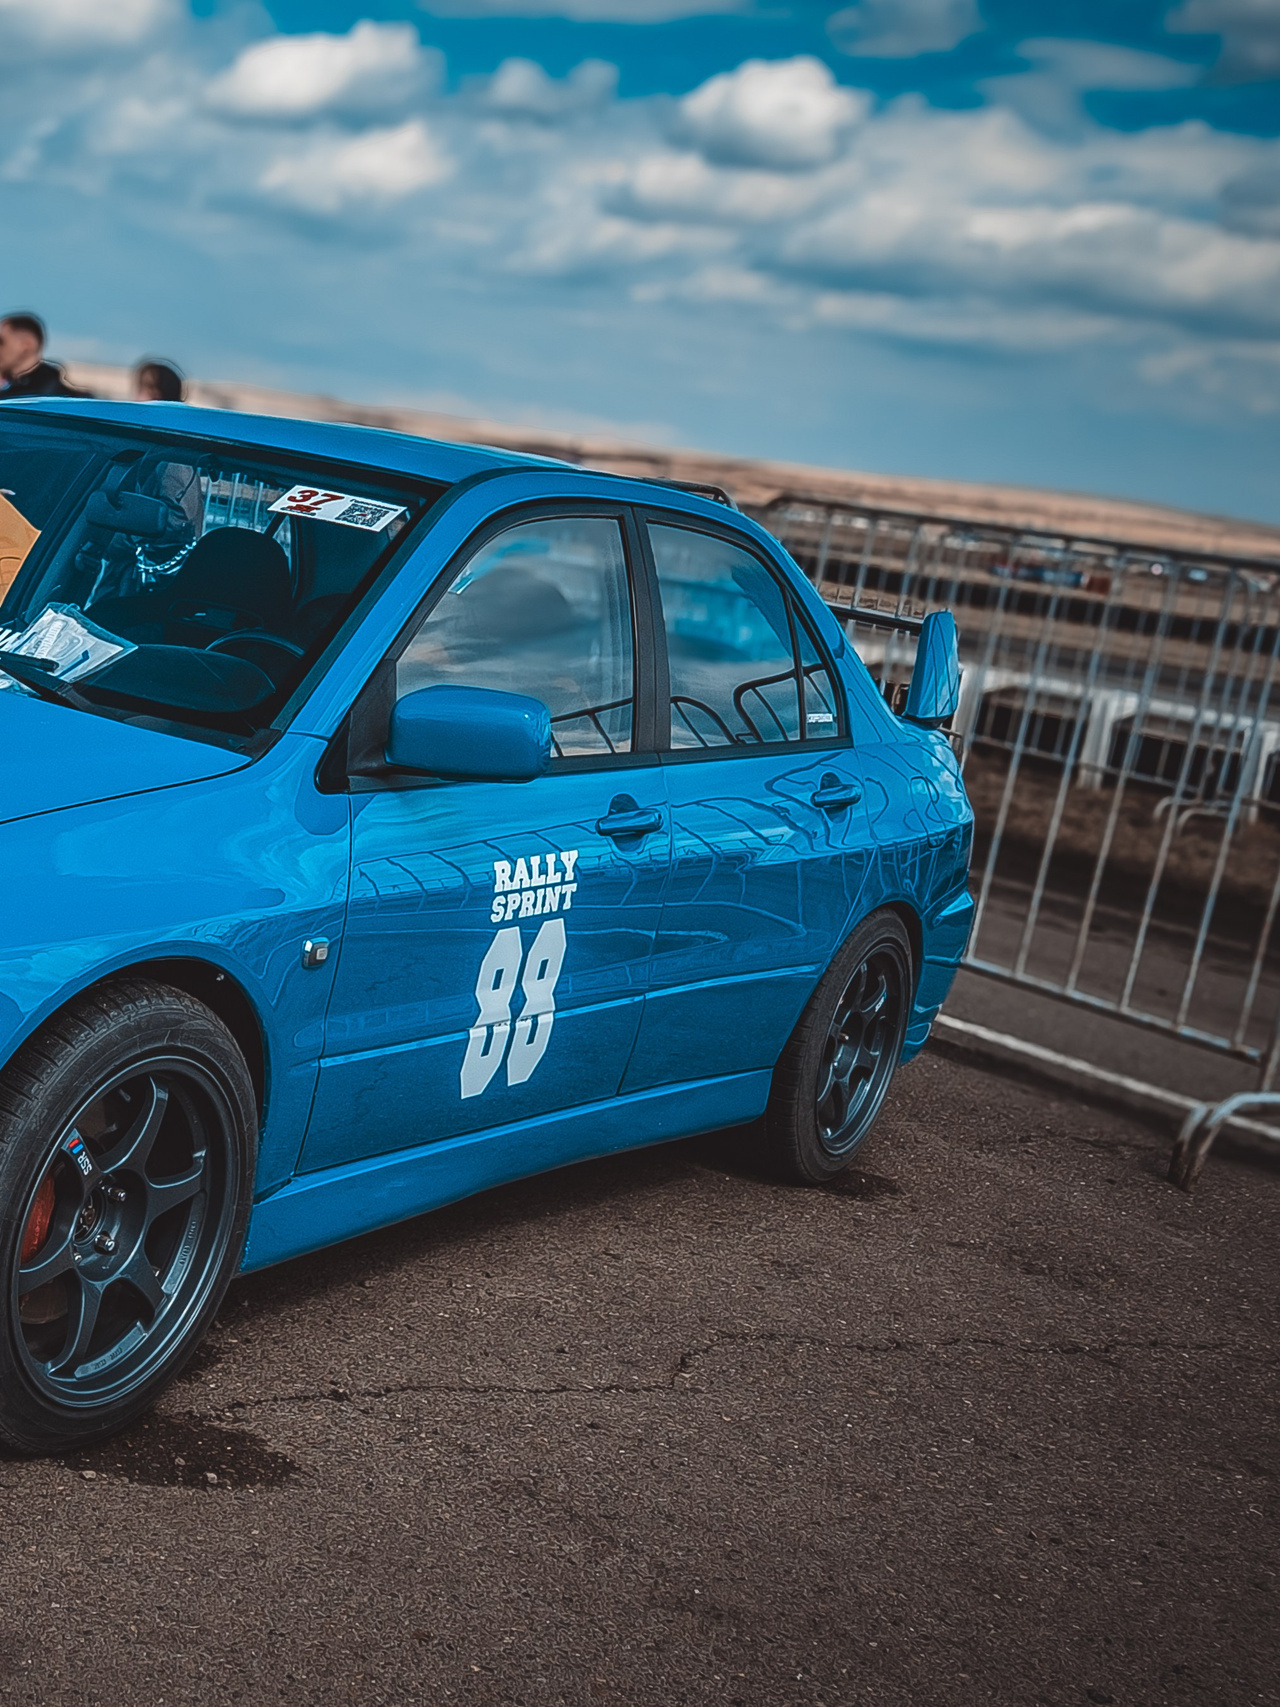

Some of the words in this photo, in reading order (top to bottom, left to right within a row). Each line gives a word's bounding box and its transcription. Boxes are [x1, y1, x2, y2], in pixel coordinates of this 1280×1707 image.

[287, 489, 346, 507] 37
[493, 849, 579, 893] RALLY
[490, 882, 578, 923] SPRINT
[460, 917, 568, 1100] 88
[77, 1151, 93, 1176] SSR
